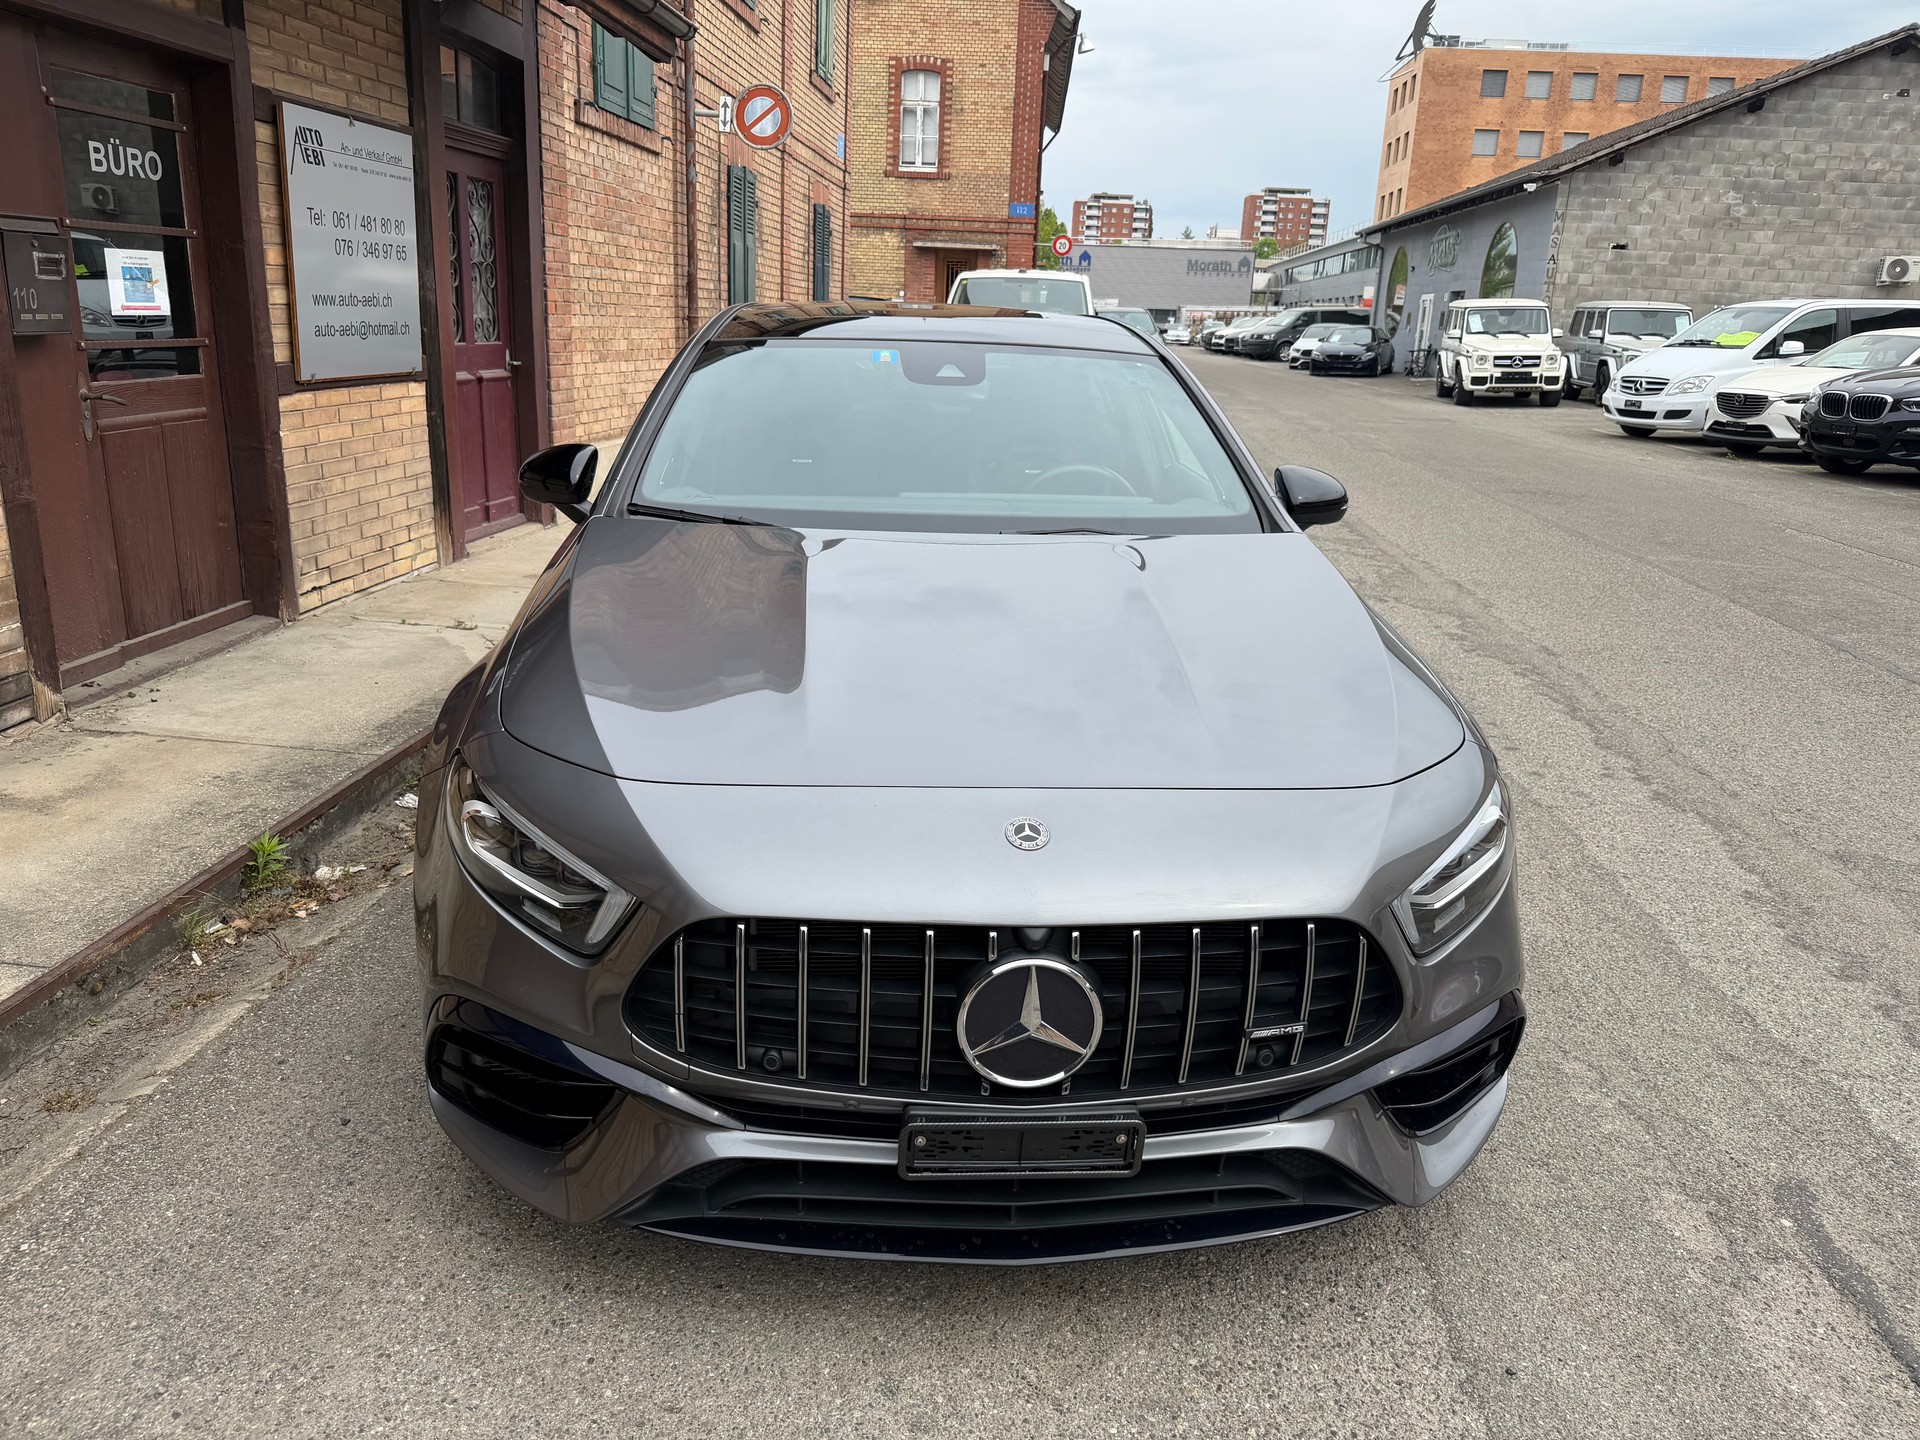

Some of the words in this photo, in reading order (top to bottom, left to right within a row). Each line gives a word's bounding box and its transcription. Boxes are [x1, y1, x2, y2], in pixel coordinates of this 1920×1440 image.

[292, 125, 324, 152] AUTO
[88, 138, 163, 181] BÜRO
[352, 146, 364, 157] und
[364, 147, 385, 161] Verkauf
[386, 152, 403, 165] GmbH
[1016, 206, 1028, 214] 112
[307, 207, 326, 227] Tel:
[332, 211, 351, 229] 061
[360, 215, 378, 233] 481
[380, 217, 392, 235] 80
[394, 219, 406, 236] 80
[334, 238, 354, 257] 076
[362, 241, 380, 259] 346
[382, 243, 394, 260] 97
[396, 244, 407, 261] 65
[1058, 241, 1067, 250] 20
[1187, 258, 1232, 271] Morath
[13, 287, 38, 310] 110
[312, 292, 393, 308] www.auto-aebi.ch
[314, 320, 410, 340] auto-aebi@hotmail.ch
[1265, 1025, 1304, 1037] AMG
